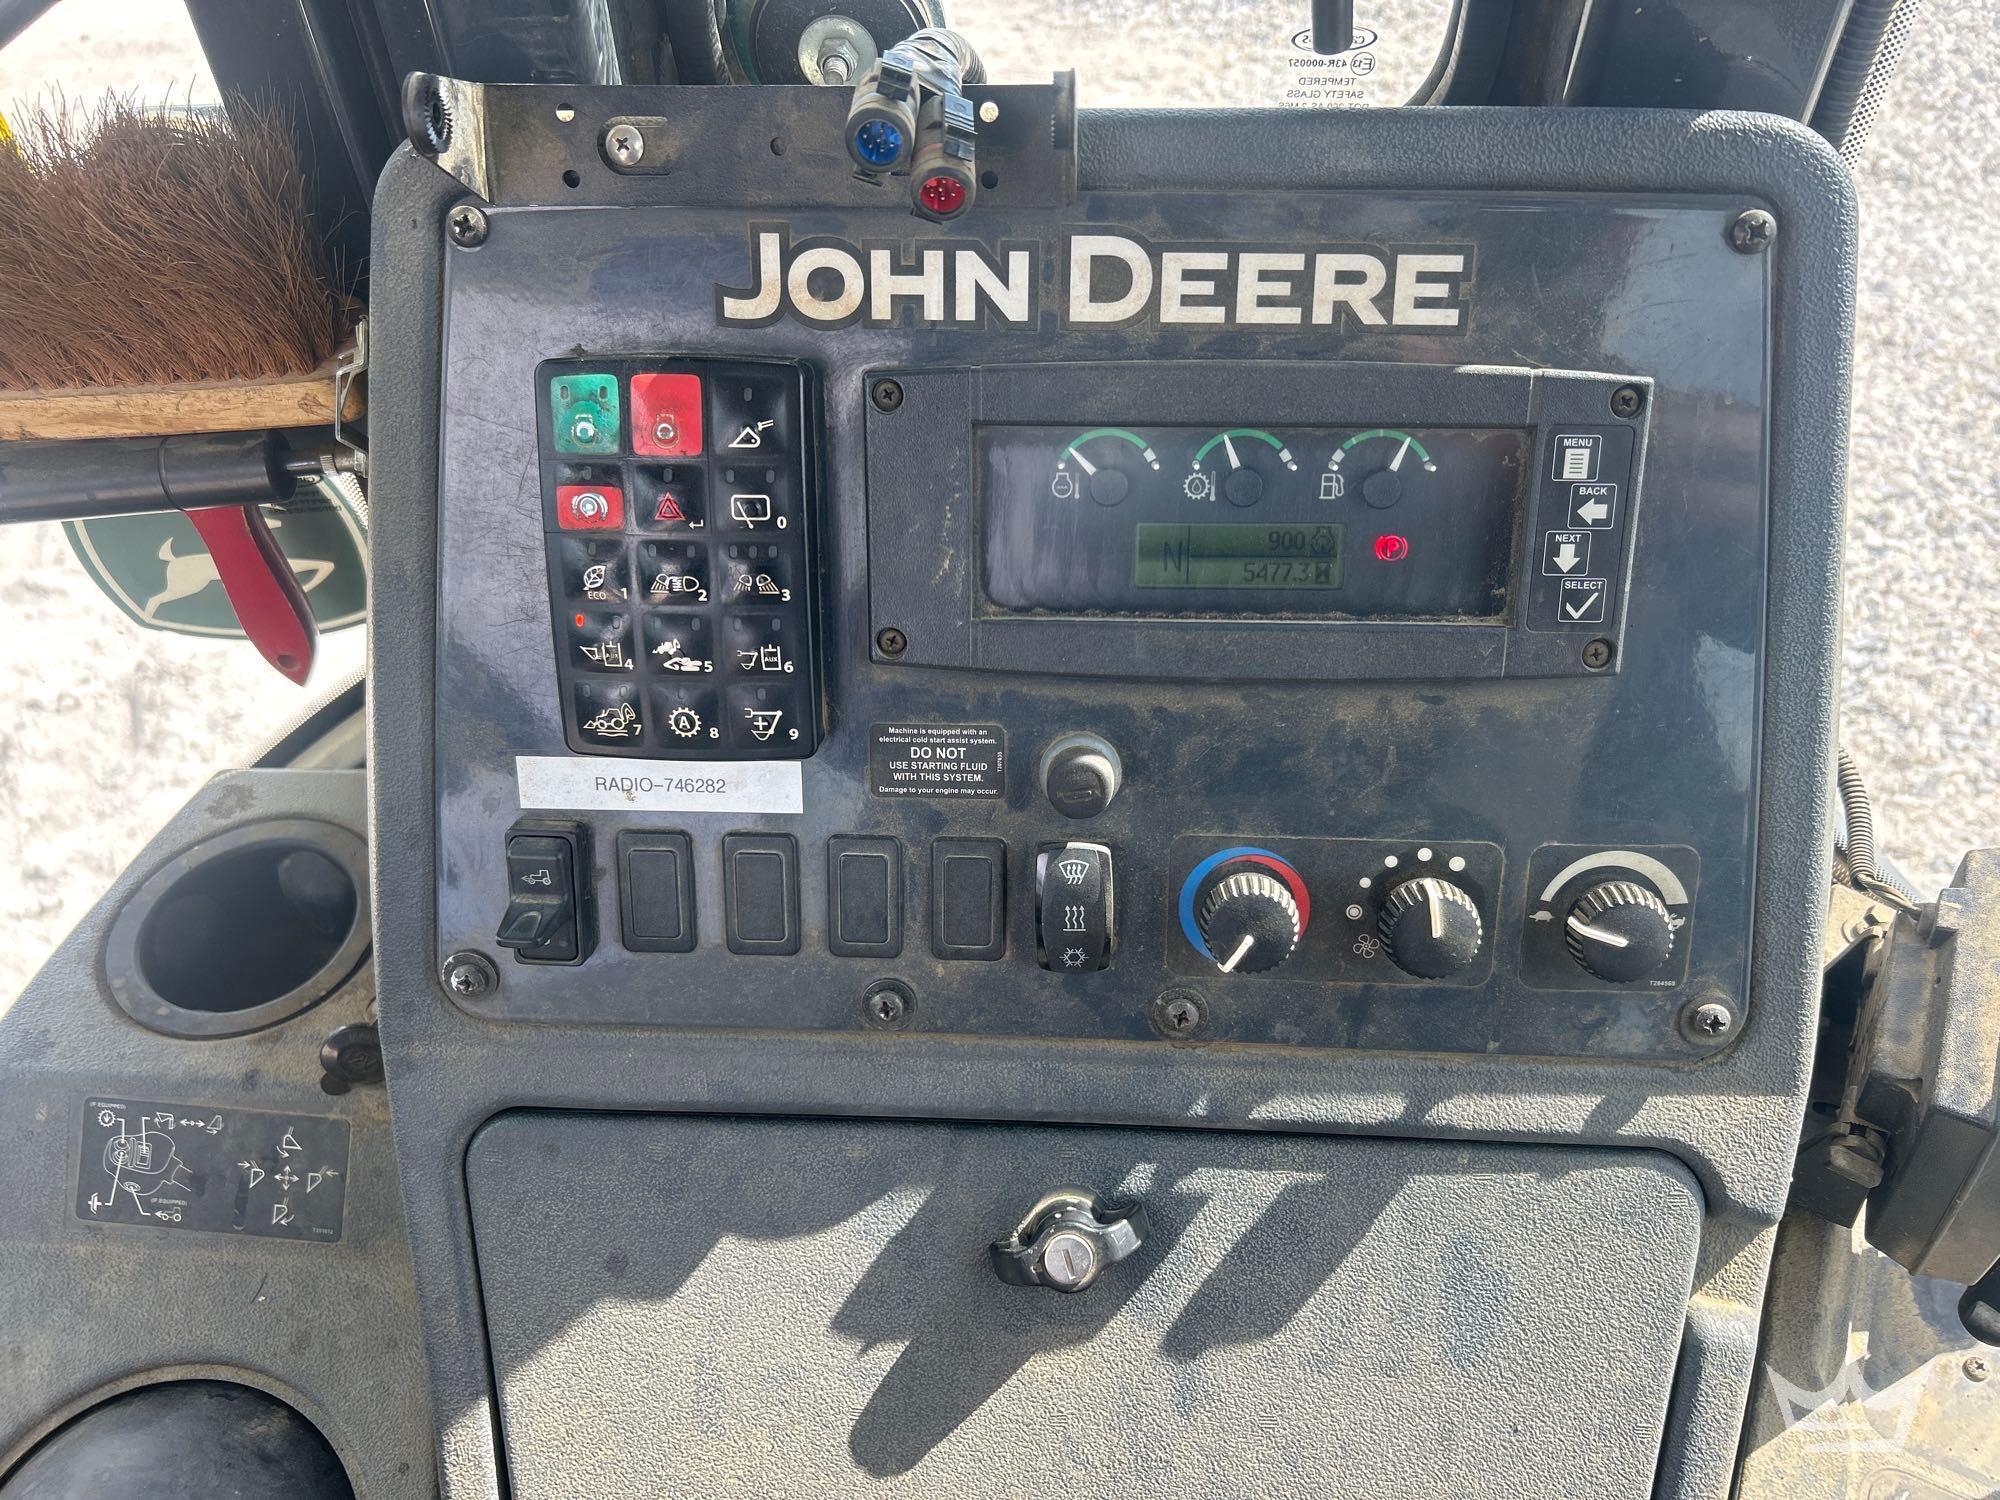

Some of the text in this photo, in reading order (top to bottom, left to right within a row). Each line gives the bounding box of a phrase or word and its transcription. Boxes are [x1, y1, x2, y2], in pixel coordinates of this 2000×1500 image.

[723, 232, 1464, 326] JOHN DEERE
[1563, 438, 1593, 447] MENU
[1579, 487, 1608, 496] BACK
[776, 516, 786, 528] 0
[1268, 531, 1305, 550] 900
[1555, 534, 1582, 542] NEXT
[1163, 540, 1183, 573] N
[1243, 562, 1310, 583] 5477.3
[1564, 580, 1603, 590] SELECT
[588, 591, 606, 600] ECO
[620, 588, 628, 600] 1
[698, 590, 708, 602] 2
[781, 590, 791, 601] 3
[624, 658, 634, 670] 4
[704, 661, 713, 672] 5
[784, 660, 794, 673] 6
[634, 725, 642, 736] 7
[709, 728, 719, 738] 8
[788, 728, 799, 740] 9
[910, 747, 966, 759] DO NOT
[889, 761, 988, 770] USE STARTING FLUID
[893, 772, 984, 782] WITH THIS SYSTEM.
[595, 776, 726, 794] RADIO-746282
